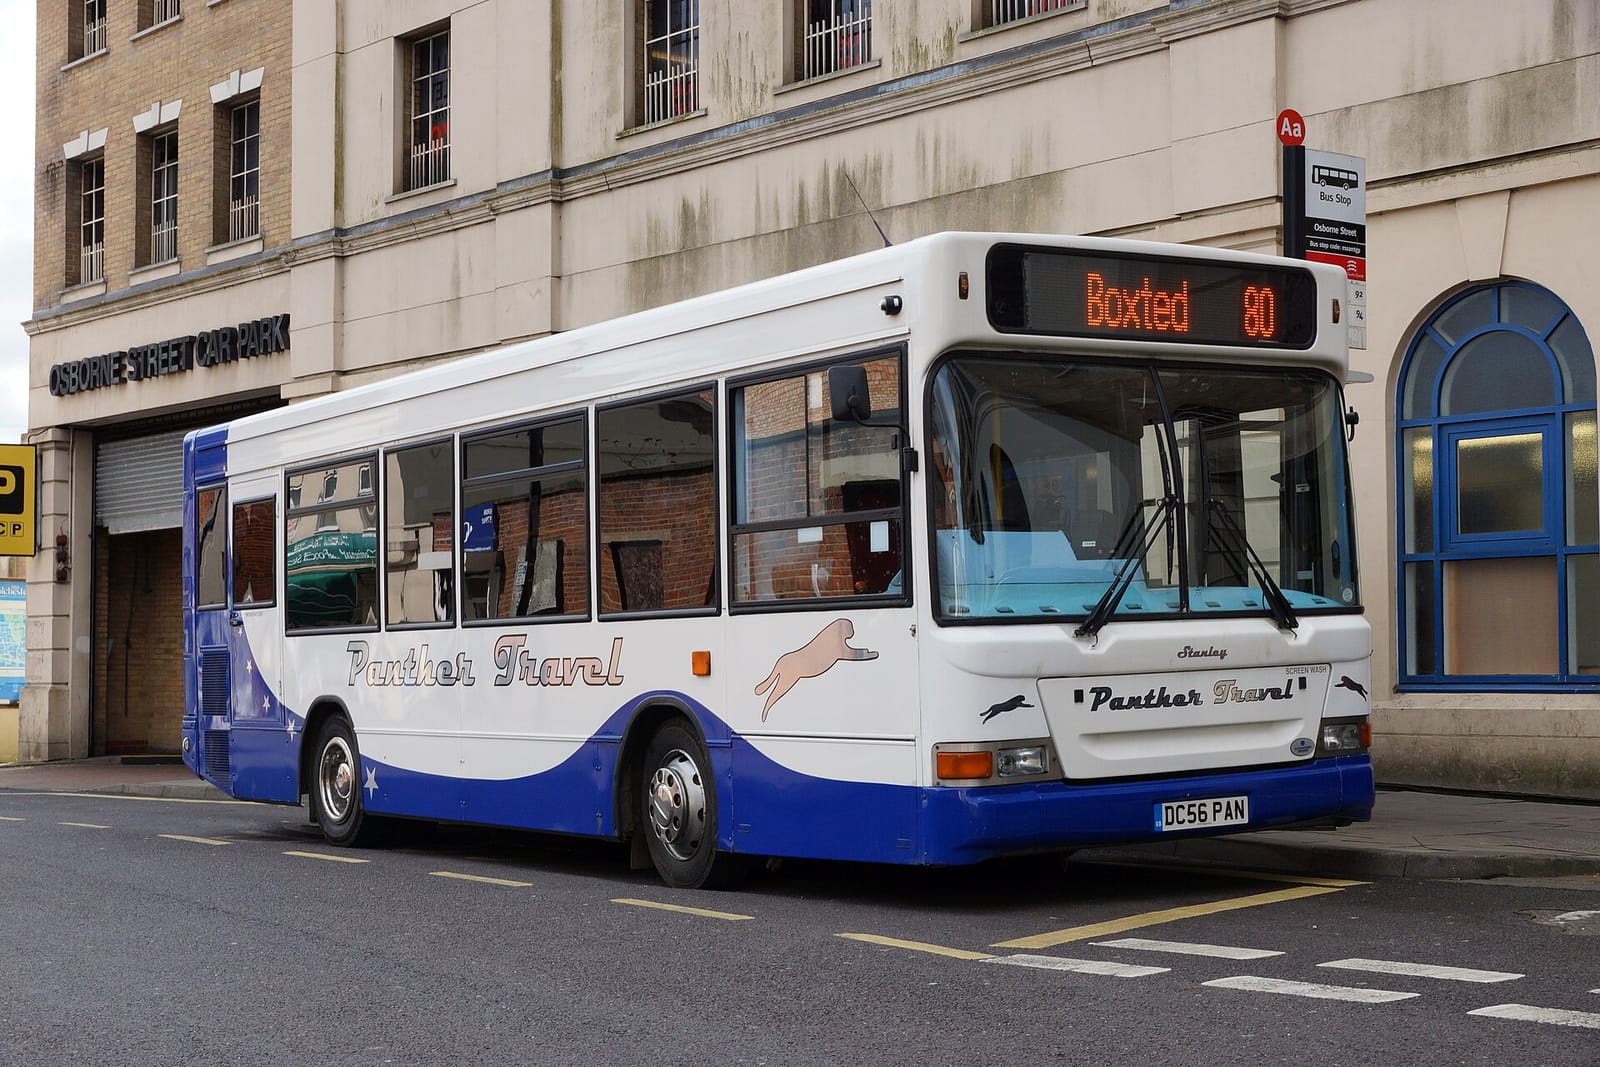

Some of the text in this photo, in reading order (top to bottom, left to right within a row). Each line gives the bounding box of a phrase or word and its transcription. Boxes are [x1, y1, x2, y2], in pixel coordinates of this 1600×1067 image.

[1280, 117, 1302, 137] Aa
[1319, 191, 1352, 207] Bus Stop
[1313, 222, 1357, 237] Osborne Street
[1354, 290, 1364, 299] 92
[1086, 272, 1275, 338] Boxted 80
[1355, 310, 1364, 321] 94
[49, 313, 290, 397] OSBORNE STREET CAR PARK
[346, 633, 624, 687] Panther Travel
[1177, 646, 1228, 660] Stanley
[1285, 665, 1327, 675] SCREEN WASH
[1089, 678, 1294, 711] Panther Travel
[1165, 799, 1245, 826] DC56 PAN
